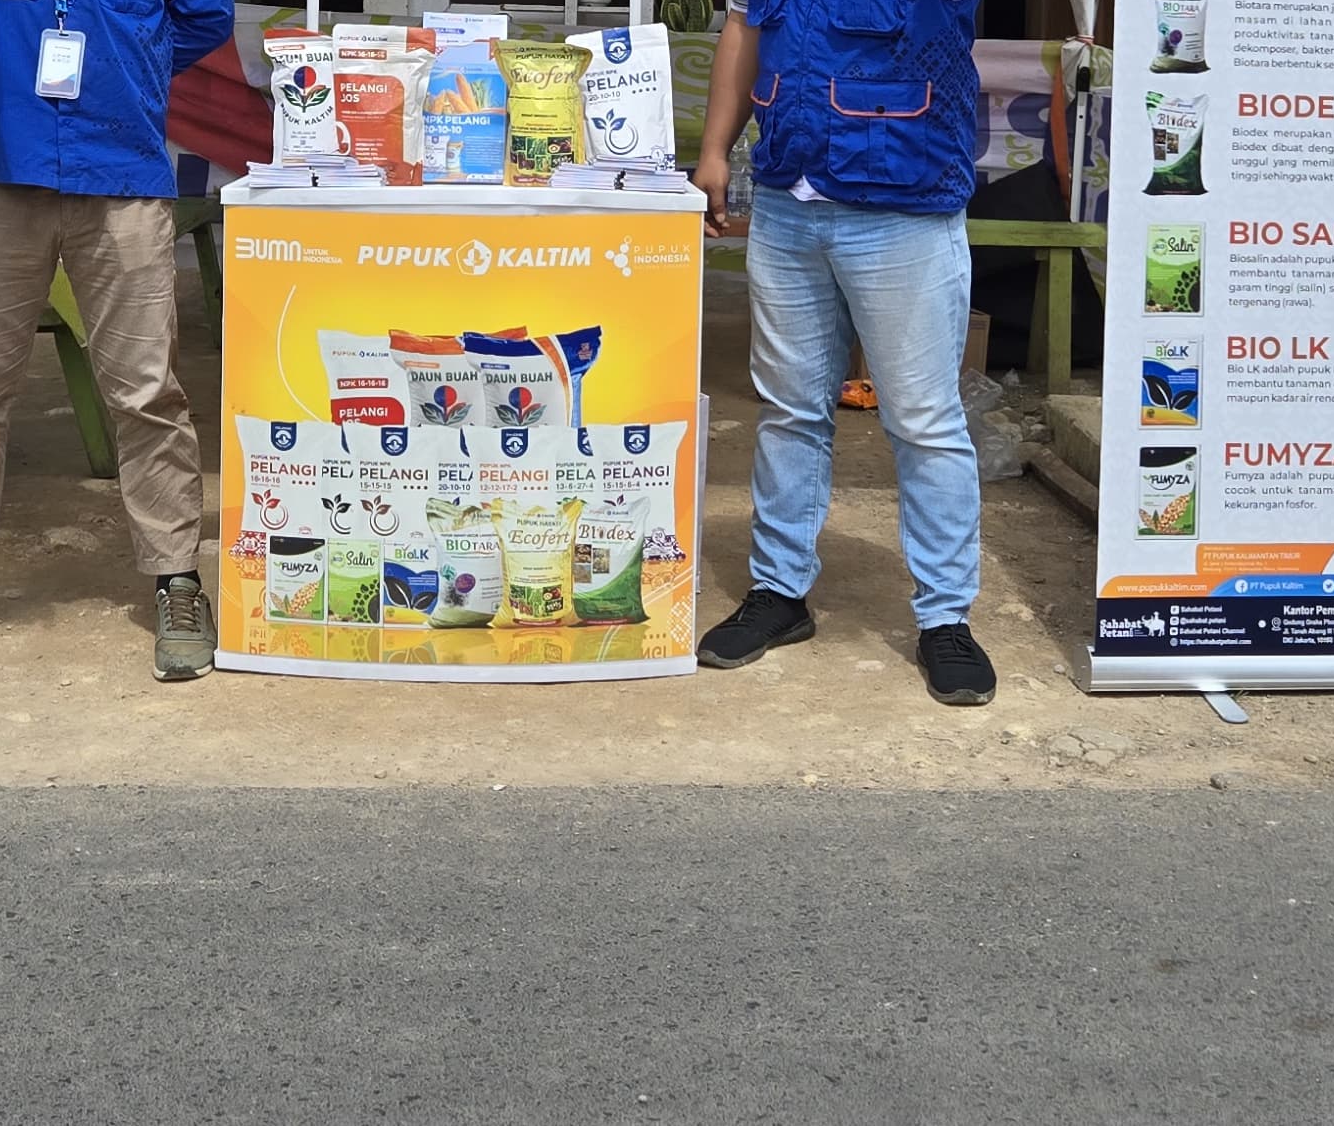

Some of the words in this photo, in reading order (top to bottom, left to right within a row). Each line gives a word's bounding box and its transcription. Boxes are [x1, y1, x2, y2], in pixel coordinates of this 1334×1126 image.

[587, 70, 656, 92] PELANGI
[340, 83, 387, 93] PELANGI
[341, 93, 360, 103] JOS
[305, 106, 334, 125] KALTIM
[445, 116, 490, 125] PELANGI
[1229, 221, 1283, 245] BIO
[235, 238, 301, 262] BUMN
[634, 244, 691, 253] PUPUK
[303, 255, 343, 264] INDONESIA
[357, 245, 452, 266] PUPUK
[497, 246, 591, 267] KALTIM
[634, 254, 691, 263] INDONESIA
[1228, 336, 1281, 360] BIO
[1292, 337, 1330, 360] LK
[411, 371, 442, 382] DAUN
[446, 371, 478, 381] BUAH
[486, 373, 516, 383] DAUN
[521, 372, 553, 382] BUAH
[339, 408, 388, 419] PELANGI
[251, 462, 316, 476] PELANGI
[360, 468, 428, 481] PELANGI
[603, 466, 669, 480] PELANGI
[479, 470, 548, 482] PELANGI
[1225, 472, 1265, 482] Fumyza
[1270, 472, 1303, 480] adalah
[360, 482, 391, 490] 15-15-15
[508, 529, 571, 550] Ecofert
[346, 551, 374, 566] Salin
[282, 562, 318, 573] FUMYZA
[1117, 583, 1207, 593] www.pupukkaltim.com
